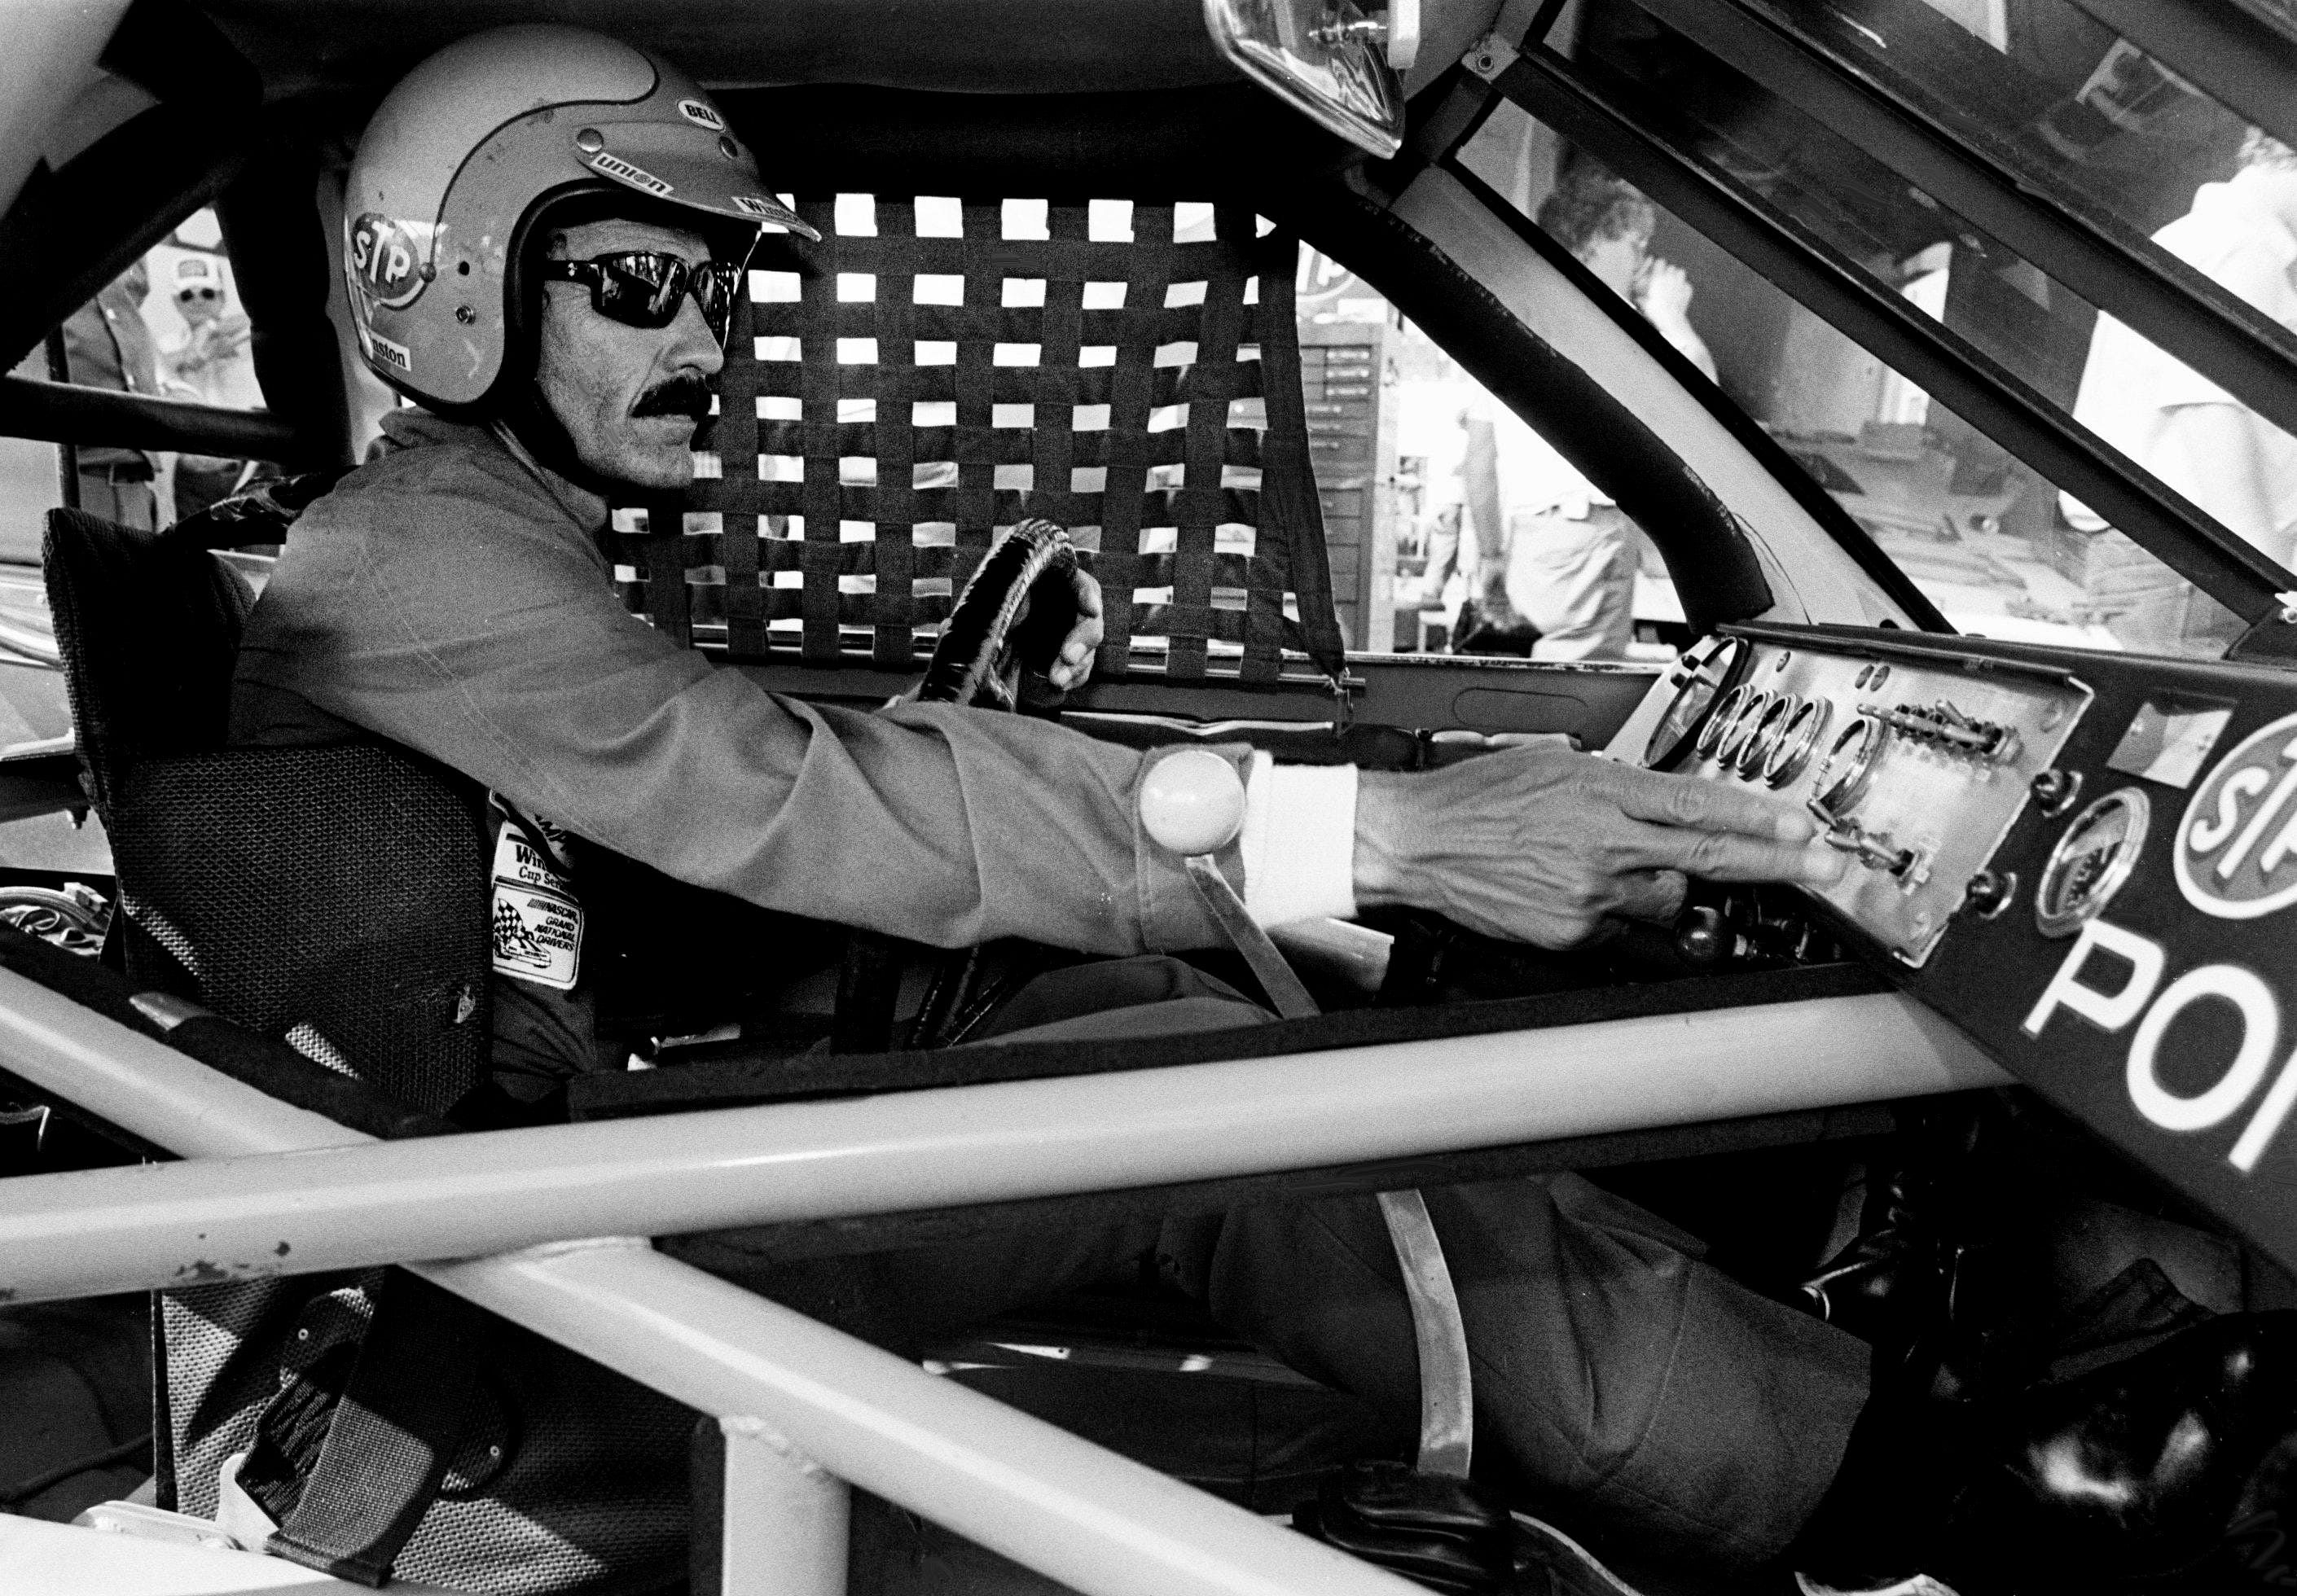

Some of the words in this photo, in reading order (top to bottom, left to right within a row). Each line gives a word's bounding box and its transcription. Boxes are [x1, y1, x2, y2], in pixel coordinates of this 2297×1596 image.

[685, 104, 720, 125] BELL
[354, 221, 411, 284] STP
[519, 866, 541, 884] Cup
